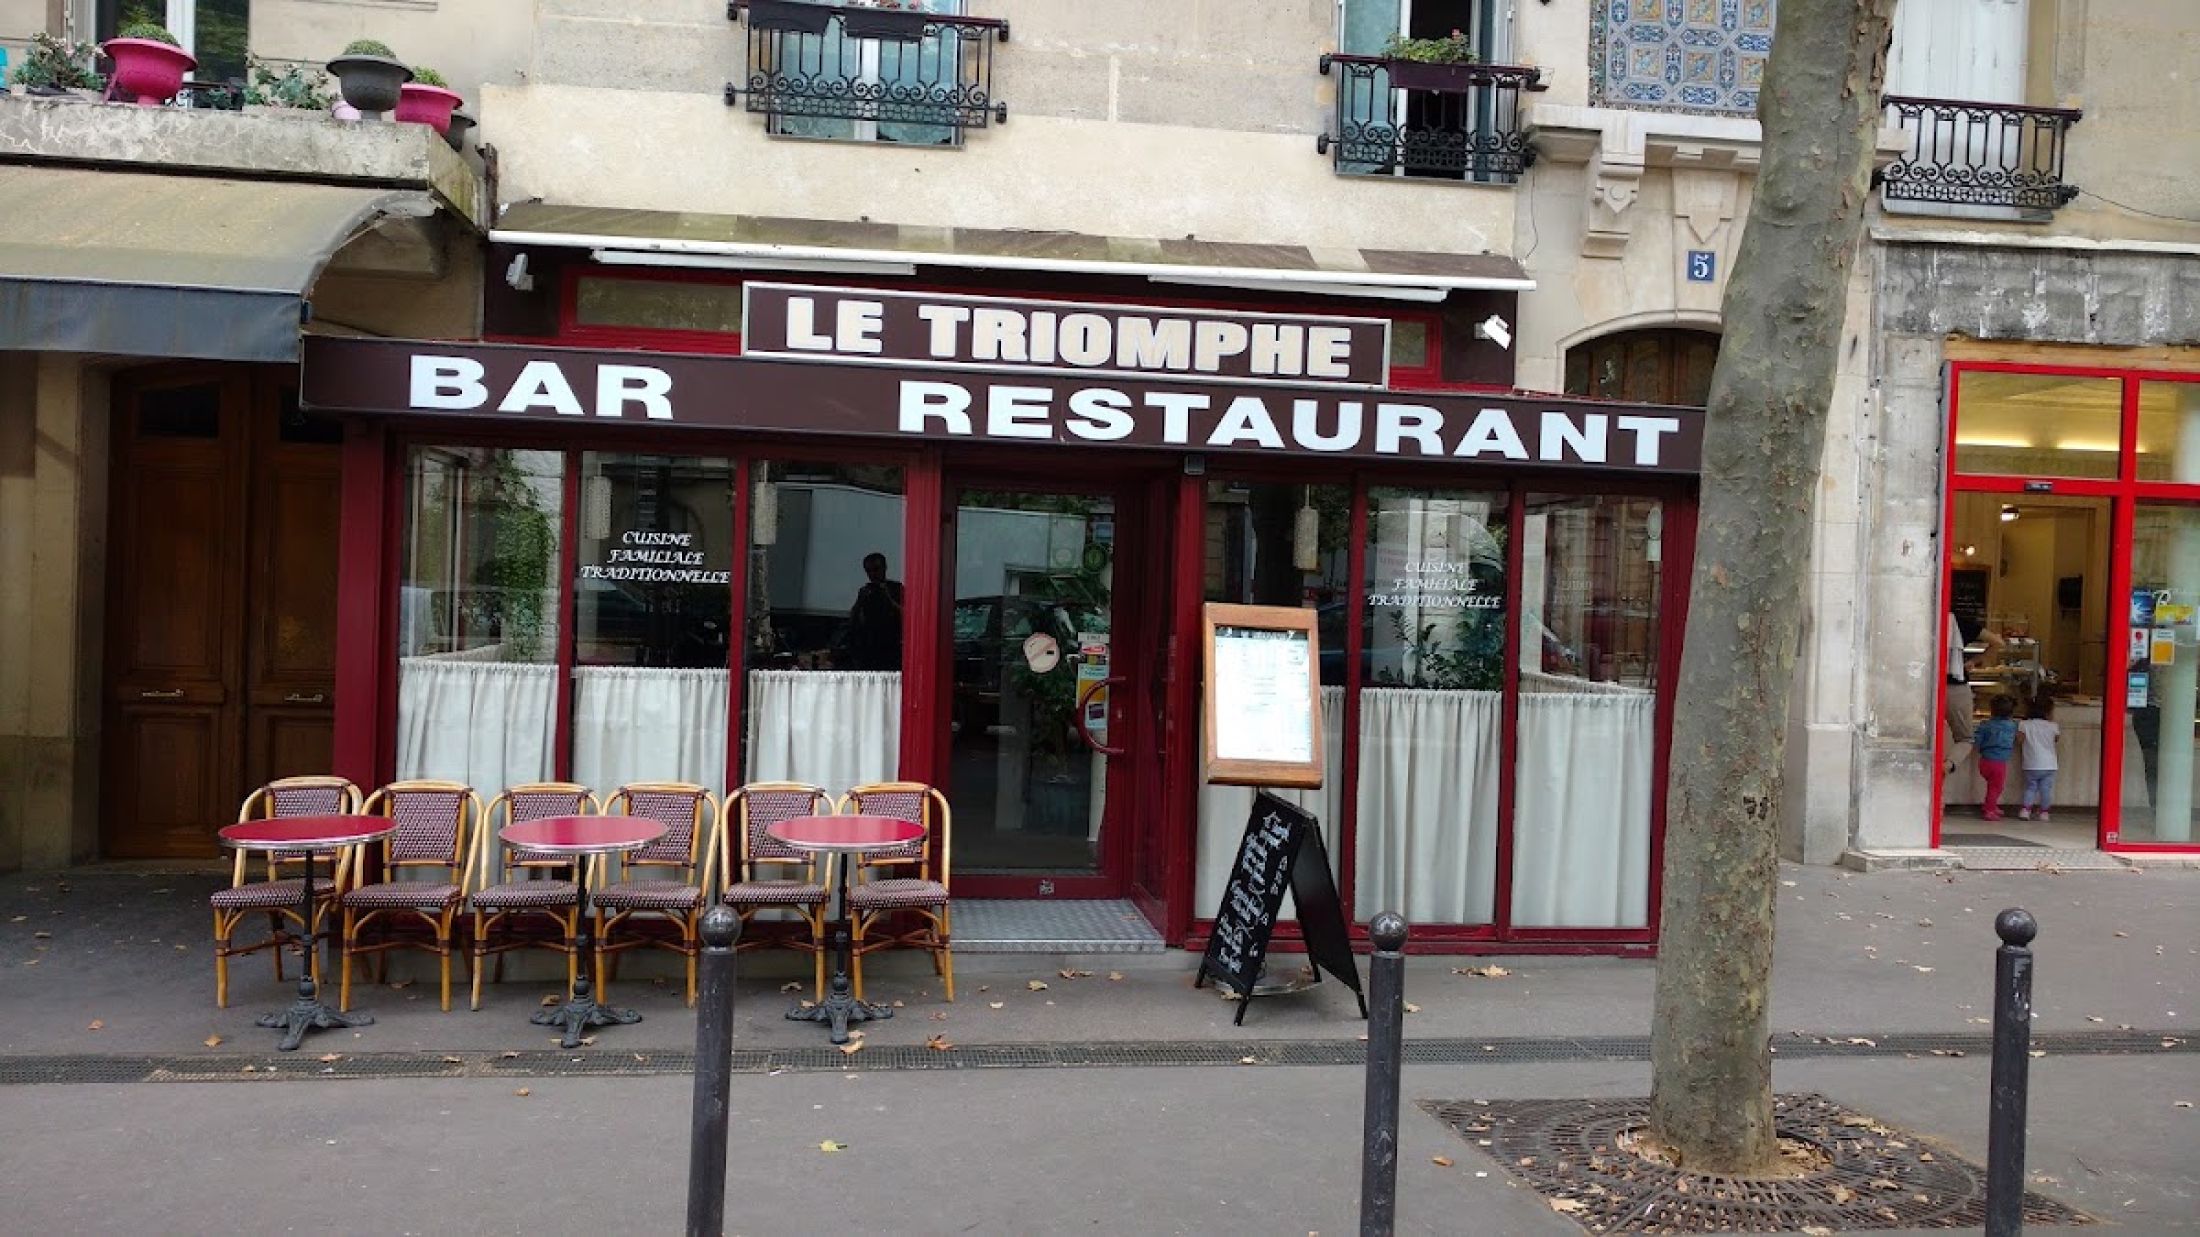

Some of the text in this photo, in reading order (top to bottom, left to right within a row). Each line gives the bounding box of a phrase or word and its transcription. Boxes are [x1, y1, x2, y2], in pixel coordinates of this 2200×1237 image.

[1693, 254, 1709, 278] 5
[786, 297, 1352, 378] LE TRIOMPHE
[409, 355, 1680, 467] BAR RESTAURANT
[622, 530, 692, 547] CUISINE
[607, 549, 704, 565] FAMILIALE
[581, 564, 731, 584] TRADITIONNELLE
[1405, 562, 1464, 573] CUISINE
[1392, 578, 1479, 591] FAMILIALE
[1368, 593, 1502, 609] TRADITIONNELLE
